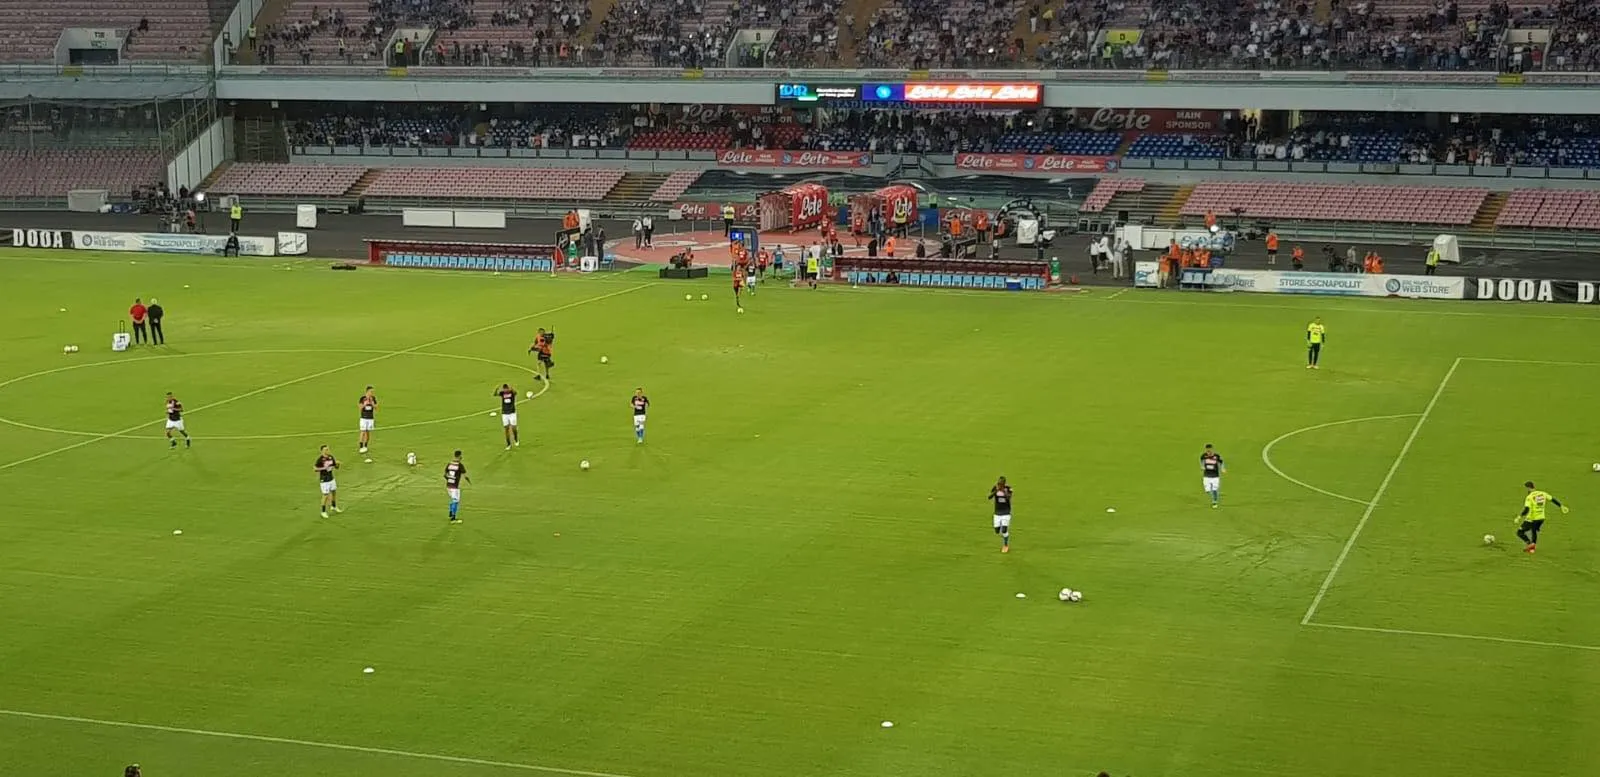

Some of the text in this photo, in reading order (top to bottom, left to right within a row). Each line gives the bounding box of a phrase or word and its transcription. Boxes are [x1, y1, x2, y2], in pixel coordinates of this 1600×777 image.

[1089, 106, 1151, 131] Lete
[1176, 111, 1201, 119] MAIN
[1166, 121, 1212, 129] SPONSOR
[720, 151, 752, 163] Lete
[796, 152, 829, 165] Lete
[961, 155, 993, 168] Lete
[1038, 156, 1074, 170] Lete
[681, 203, 704, 215] Lete
[800, 197, 822, 220] Lete
[13, 229, 63, 248] DOOA
[1423, 286, 1449, 294] STORE
[1478, 278, 1553, 301] DOOA
